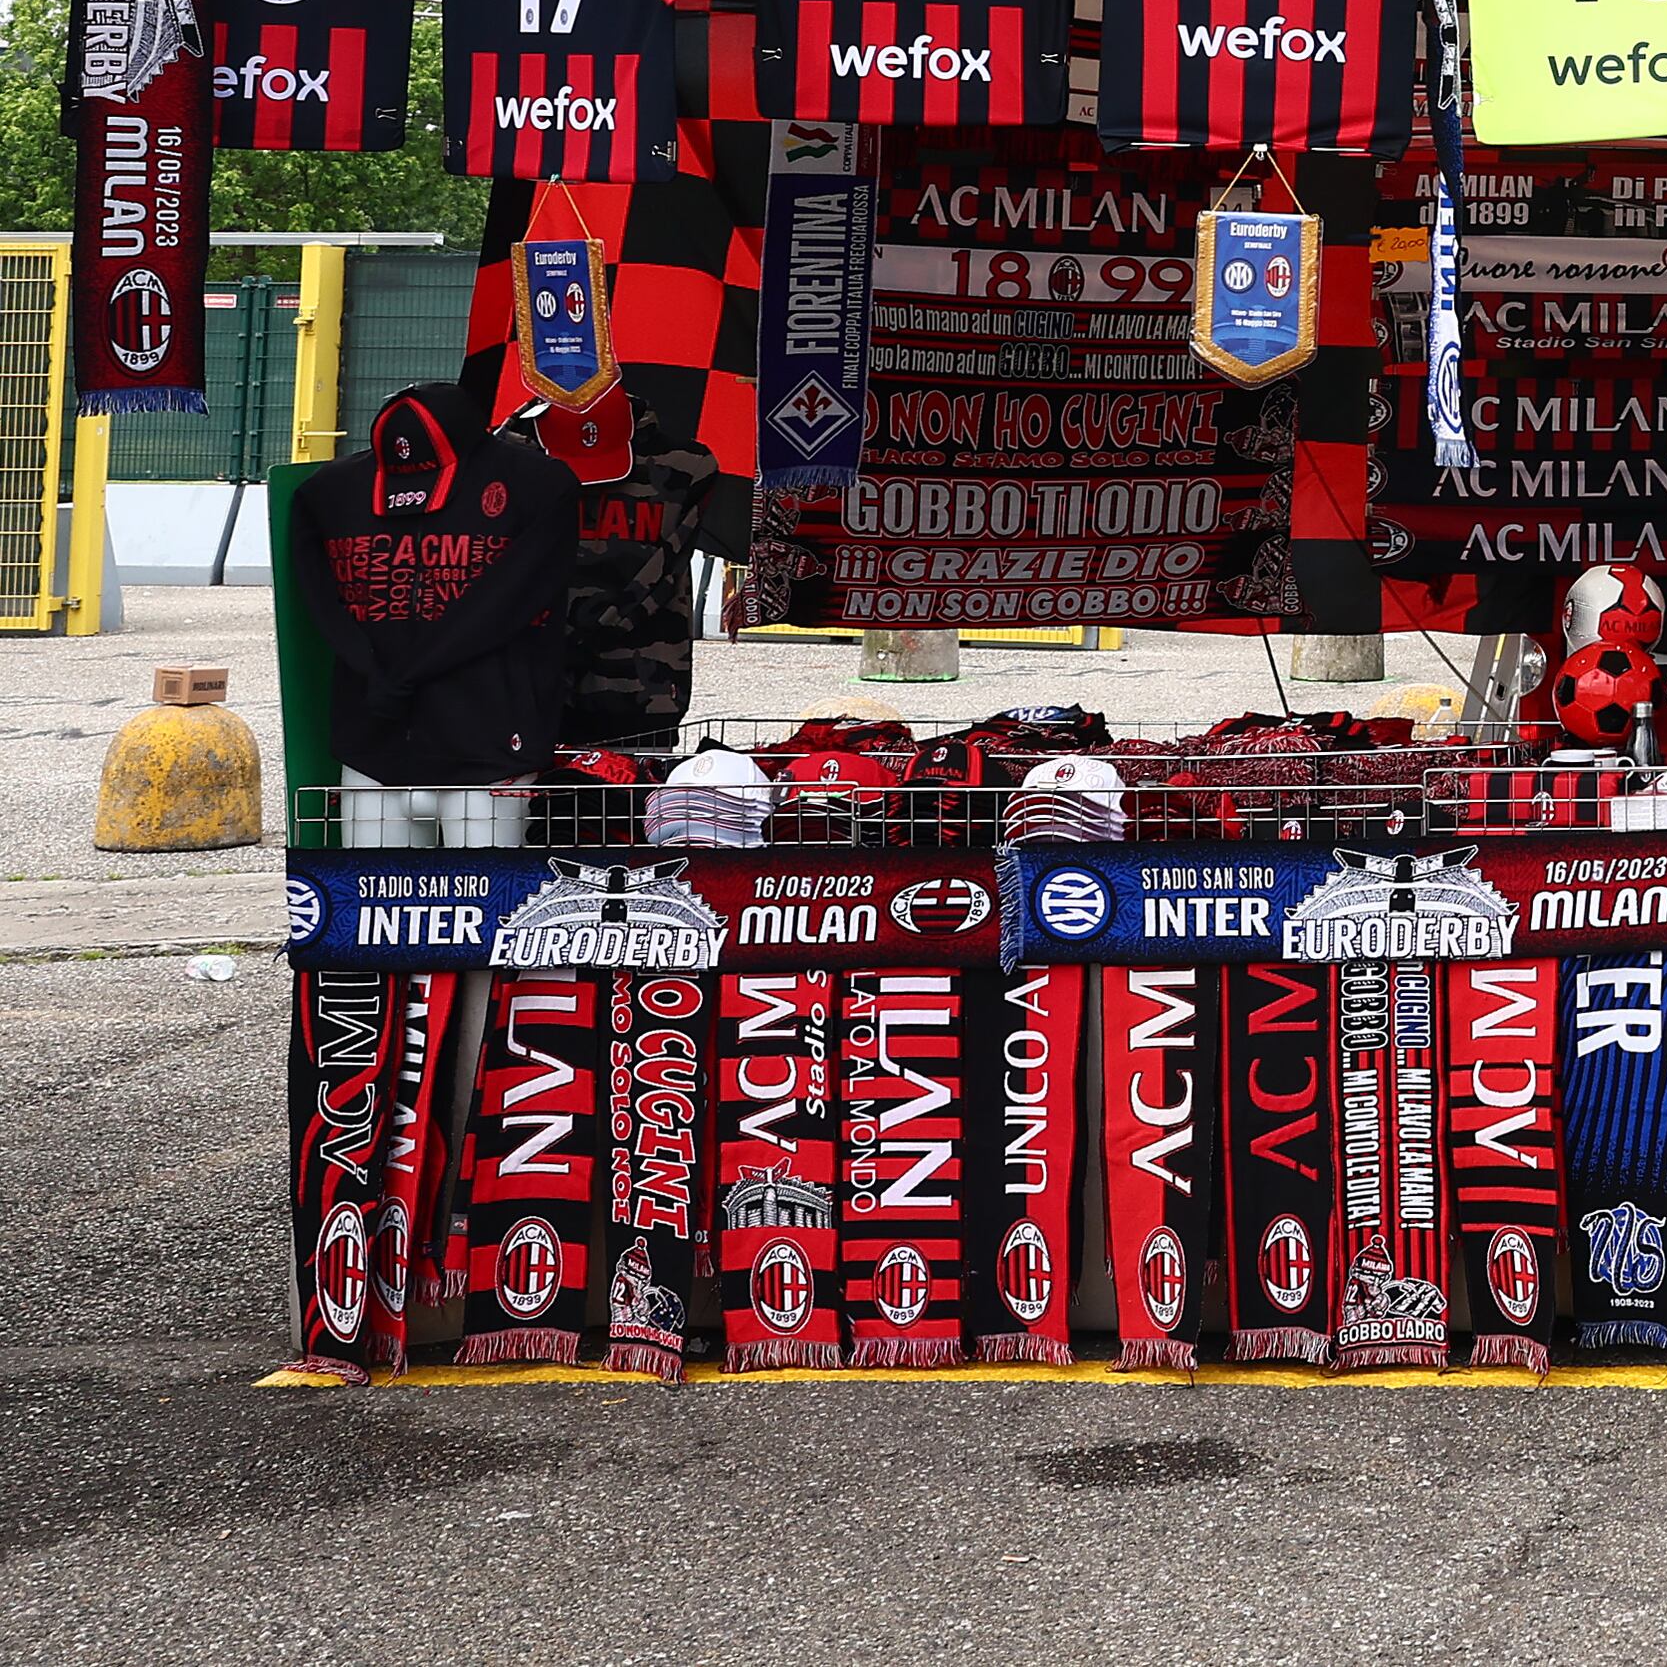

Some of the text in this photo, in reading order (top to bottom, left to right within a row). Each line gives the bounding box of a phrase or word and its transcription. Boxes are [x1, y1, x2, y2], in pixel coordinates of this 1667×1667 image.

[830, 35, 992, 82] wefox
[1178, 15, 1346, 63] wefox
[496, 85, 617, 130] wefox
[101, 115, 149, 258] MILAN
[152, 126, 180, 247] 16/05/2023
[911, 184, 1166, 233] AC MILAN
[1613, 177, 1645, 202] Di
[1230, 222, 1286, 239] Euroderby
[1614, 202, 1648, 228] in
[786, 192, 848, 355] FIORENTINA
[1463, 302, 1529, 333] AC
[891, 390, 1223, 448] NON HO CUGINI
[842, 478, 1222, 538] GOBBO TI ODIO
[890, 541, 1203, 584] GRAZIE DIO
[843, 585, 1159, 621] NON SON GOBBO
[358, 876, 489, 898] STADIO SAN SIRO
[755, 875, 873, 898] 16/05/2023
[1545, 855, 1667, 884] 16/05/2023
[359, 905, 482, 946] INTER
[738, 903, 876, 946] MILAN
[1143, 895, 1271, 939] INTER
[1281, 913, 1520, 962] EURODERBY
[489, 926, 729, 970] EURODERBY
[1004, 1031, 1050, 1195] UNICO
[848, 1098, 876, 1214] MONDO
[1339, 1319, 1446, 1343] GOBBO LADRO
